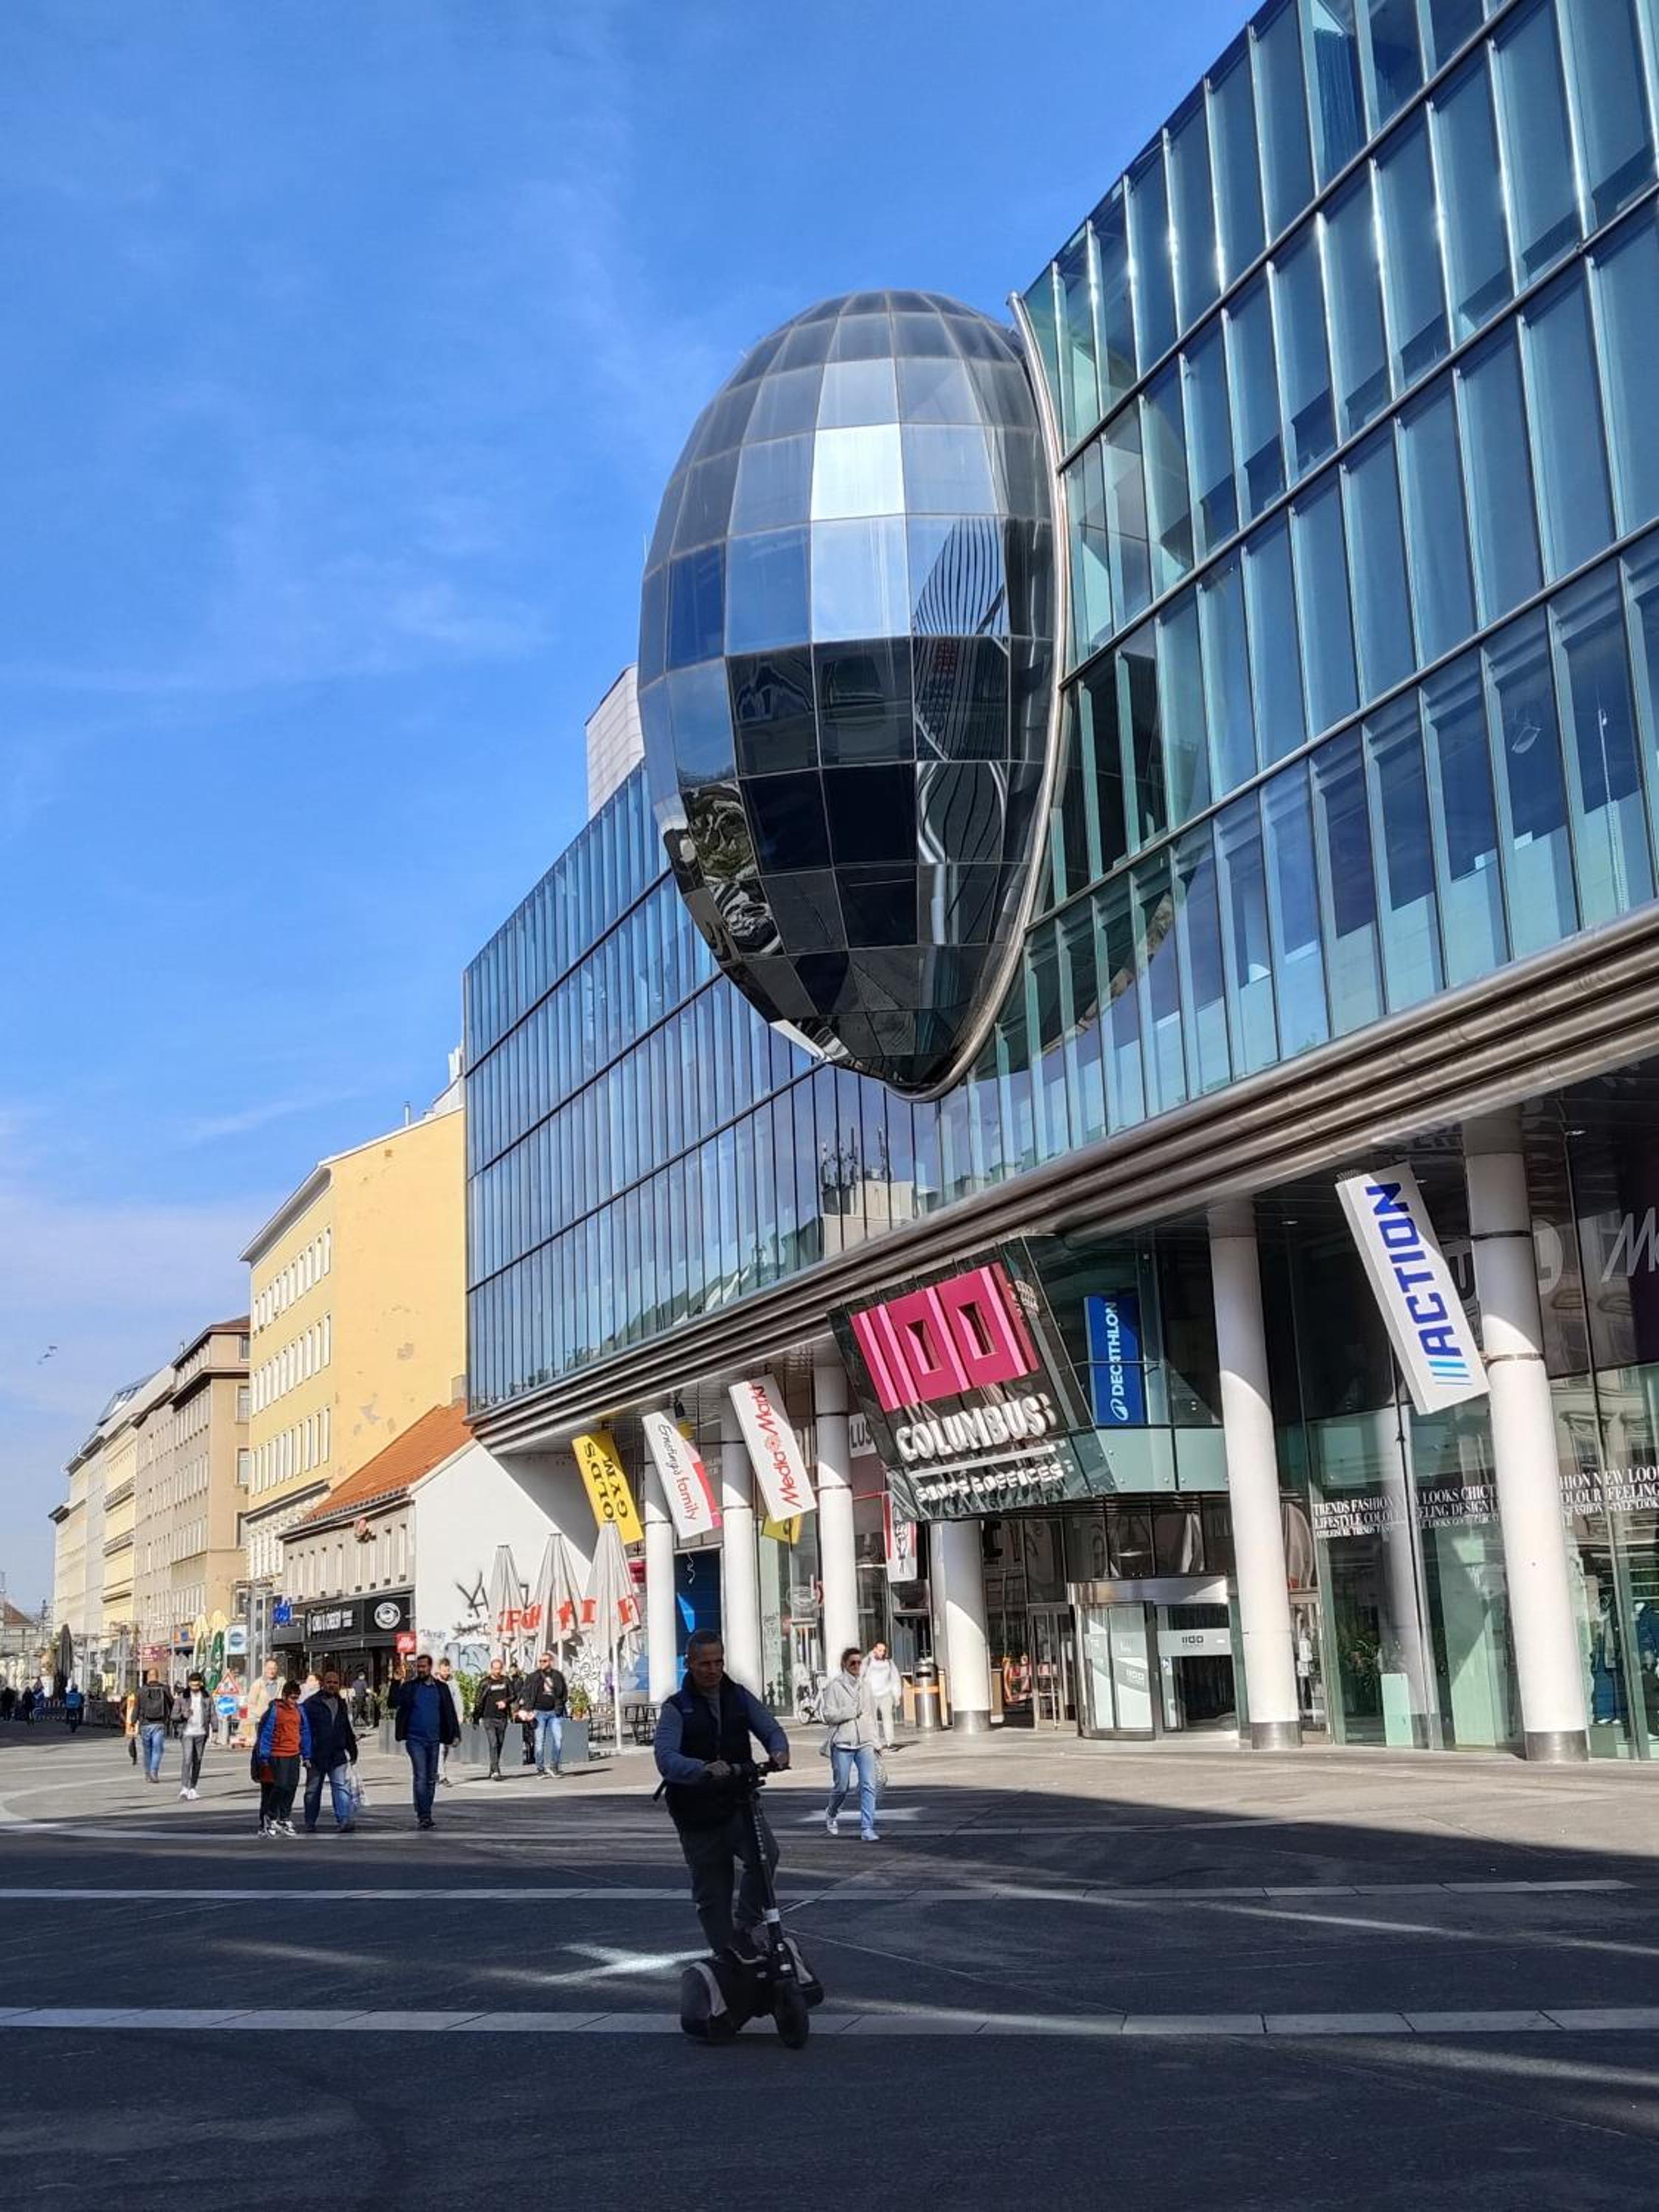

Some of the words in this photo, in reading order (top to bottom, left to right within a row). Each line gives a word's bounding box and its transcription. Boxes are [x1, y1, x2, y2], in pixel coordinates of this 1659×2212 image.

[1366, 1182, 1463, 1357] ACTION
[1601, 1206, 1659, 1283] M
[1105, 1301, 1124, 1396] DECATHLON
[896, 1394, 1048, 1462] COLUMBUS
[584, 1441, 615, 1519] OLD'S
[602, 1455, 628, 1519] GYM
[676, 1475, 700, 1520] family
[1314, 1500, 1350, 1517] TRENDS
[1350, 1496, 1393, 1513] FASHION
[1422, 1487, 1459, 1505] LOOKS
[1559, 1487, 1603, 1506] OLOUR
[1627, 1465, 1659, 1484] LOO
[1315, 1512, 1362, 1530] LIFESTYLE
